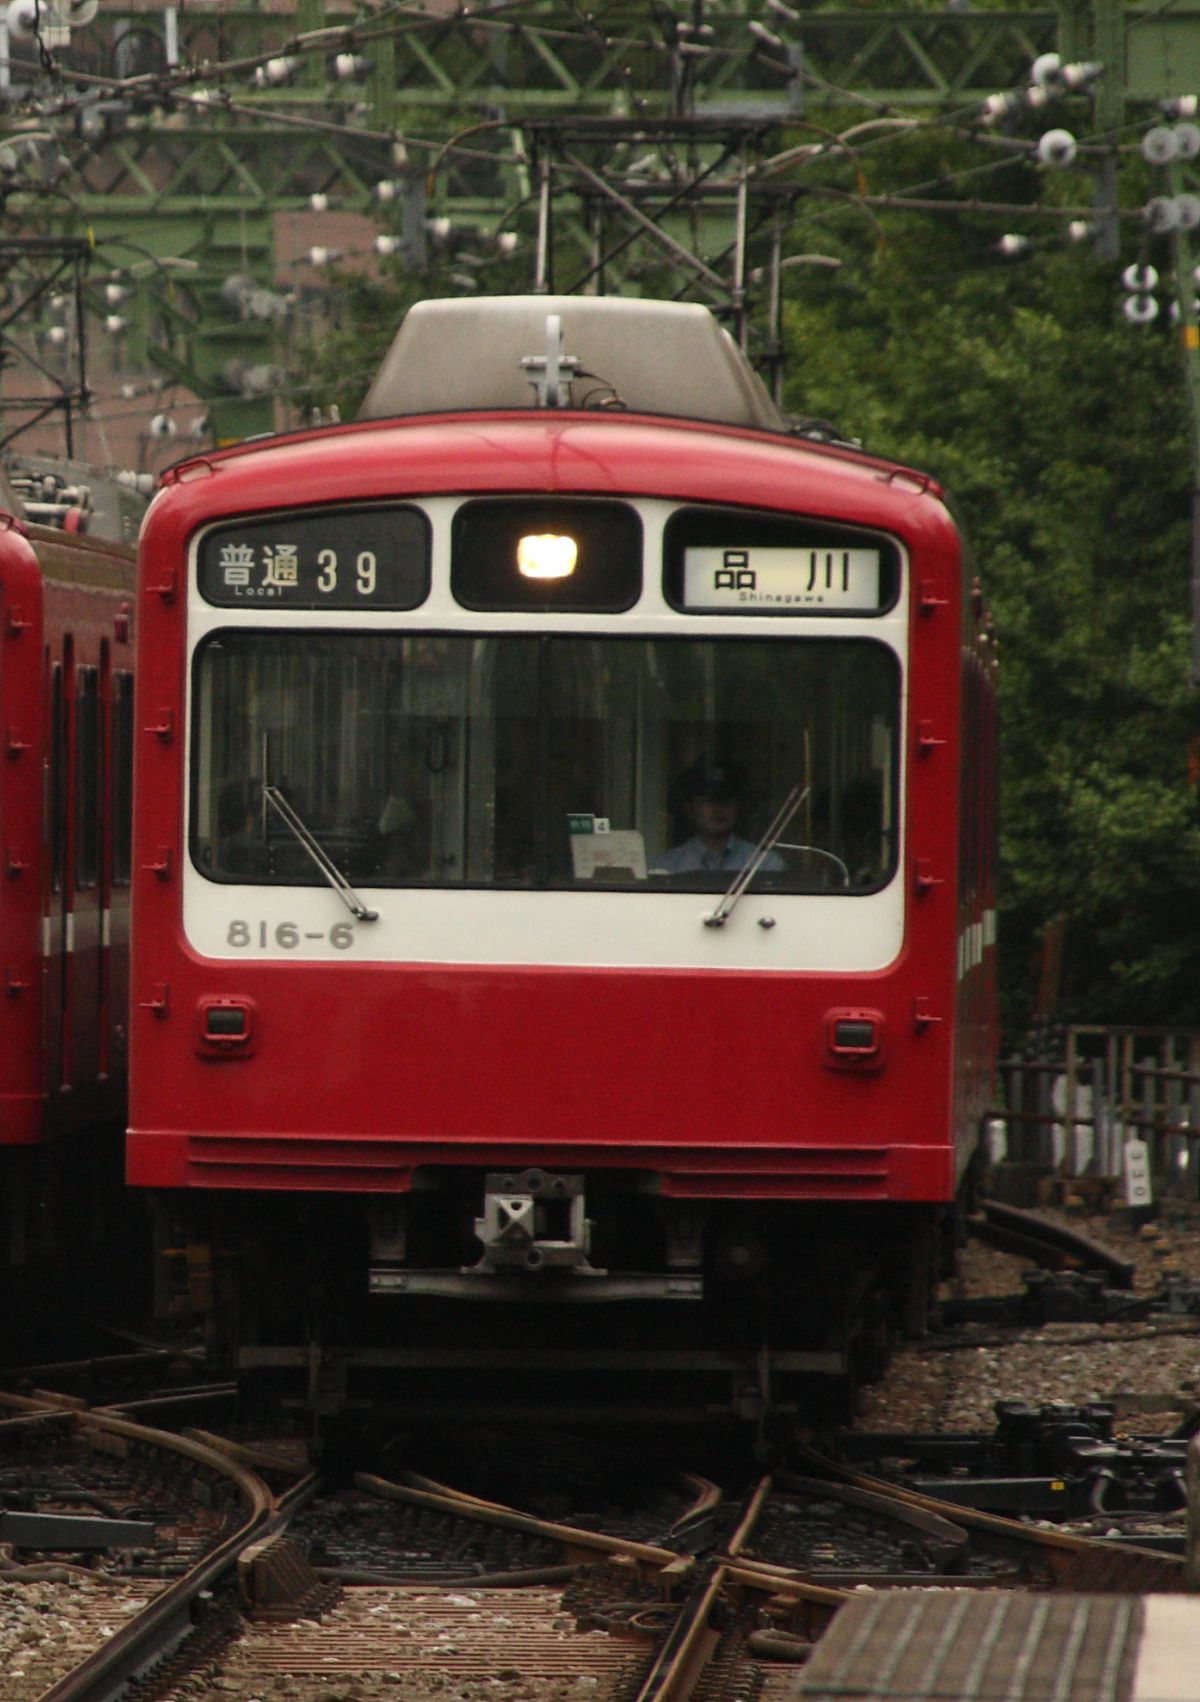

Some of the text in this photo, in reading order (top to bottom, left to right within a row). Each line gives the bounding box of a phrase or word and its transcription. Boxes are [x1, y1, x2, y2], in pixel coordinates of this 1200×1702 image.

[219, 544, 377, 595] 普通 39
[714, 551, 848, 592] 品川
[235, 586, 282, 596] Local
[226, 919, 355, 950] 816-6
